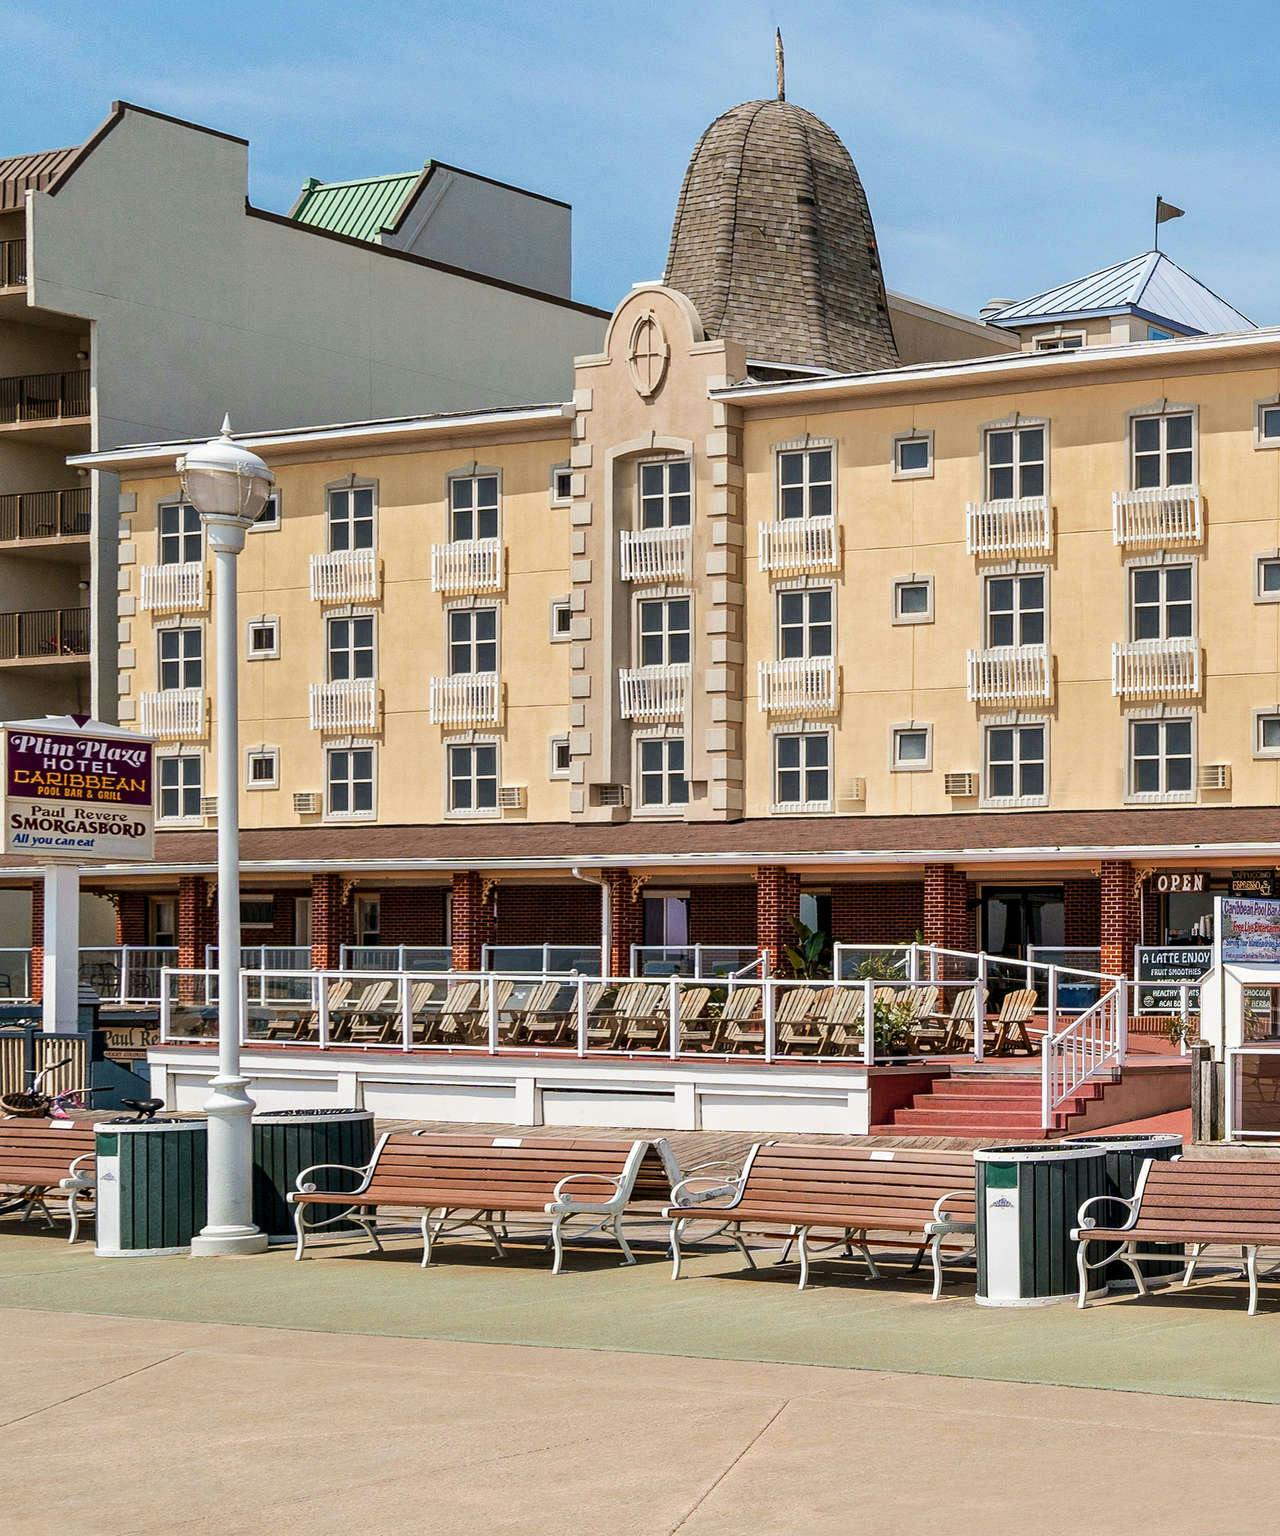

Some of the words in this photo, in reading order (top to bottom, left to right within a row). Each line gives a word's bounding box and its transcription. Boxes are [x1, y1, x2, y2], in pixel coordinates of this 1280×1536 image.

[10, 735, 75, 757] Plim
[76, 740, 147, 768] Plaza
[43, 757, 118, 775] HOTEL
[14, 769, 146, 793] CARIBBEAN
[37, 785, 61, 796] POOL
[64, 788, 83, 798] BAR
[86, 789, 93, 799] &
[97, 790, 122, 801] GRILL
[31, 805, 66, 819] Paul
[74, 808, 128, 822] Revere
[11, 813, 146, 839] SMORGASBORD
[12, 833, 29, 844] All
[31, 836, 53, 847] you
[55, 838, 75, 847] can
[76, 838, 96, 847] eat
[1157, 874, 1204, 892] OPEN
[1224, 900, 1254, 916] Caribbean
[1254, 902, 1267, 916] Pool
[1267, 902, 1278, 917] Bar
[1142, 953, 1150, 964] A
[1151, 952, 1181, 964] LATTE
[1182, 952, 1210, 964] ENJOY
[1151, 968, 1167, 976] FRUIT
[1168, 968, 1202, 976] SMOOTHIES
[1152, 989, 1178, 997] HEALTHY
[1158, 1000, 1172, 1008] ACAI
[104, 1028, 135, 1047] Paul
